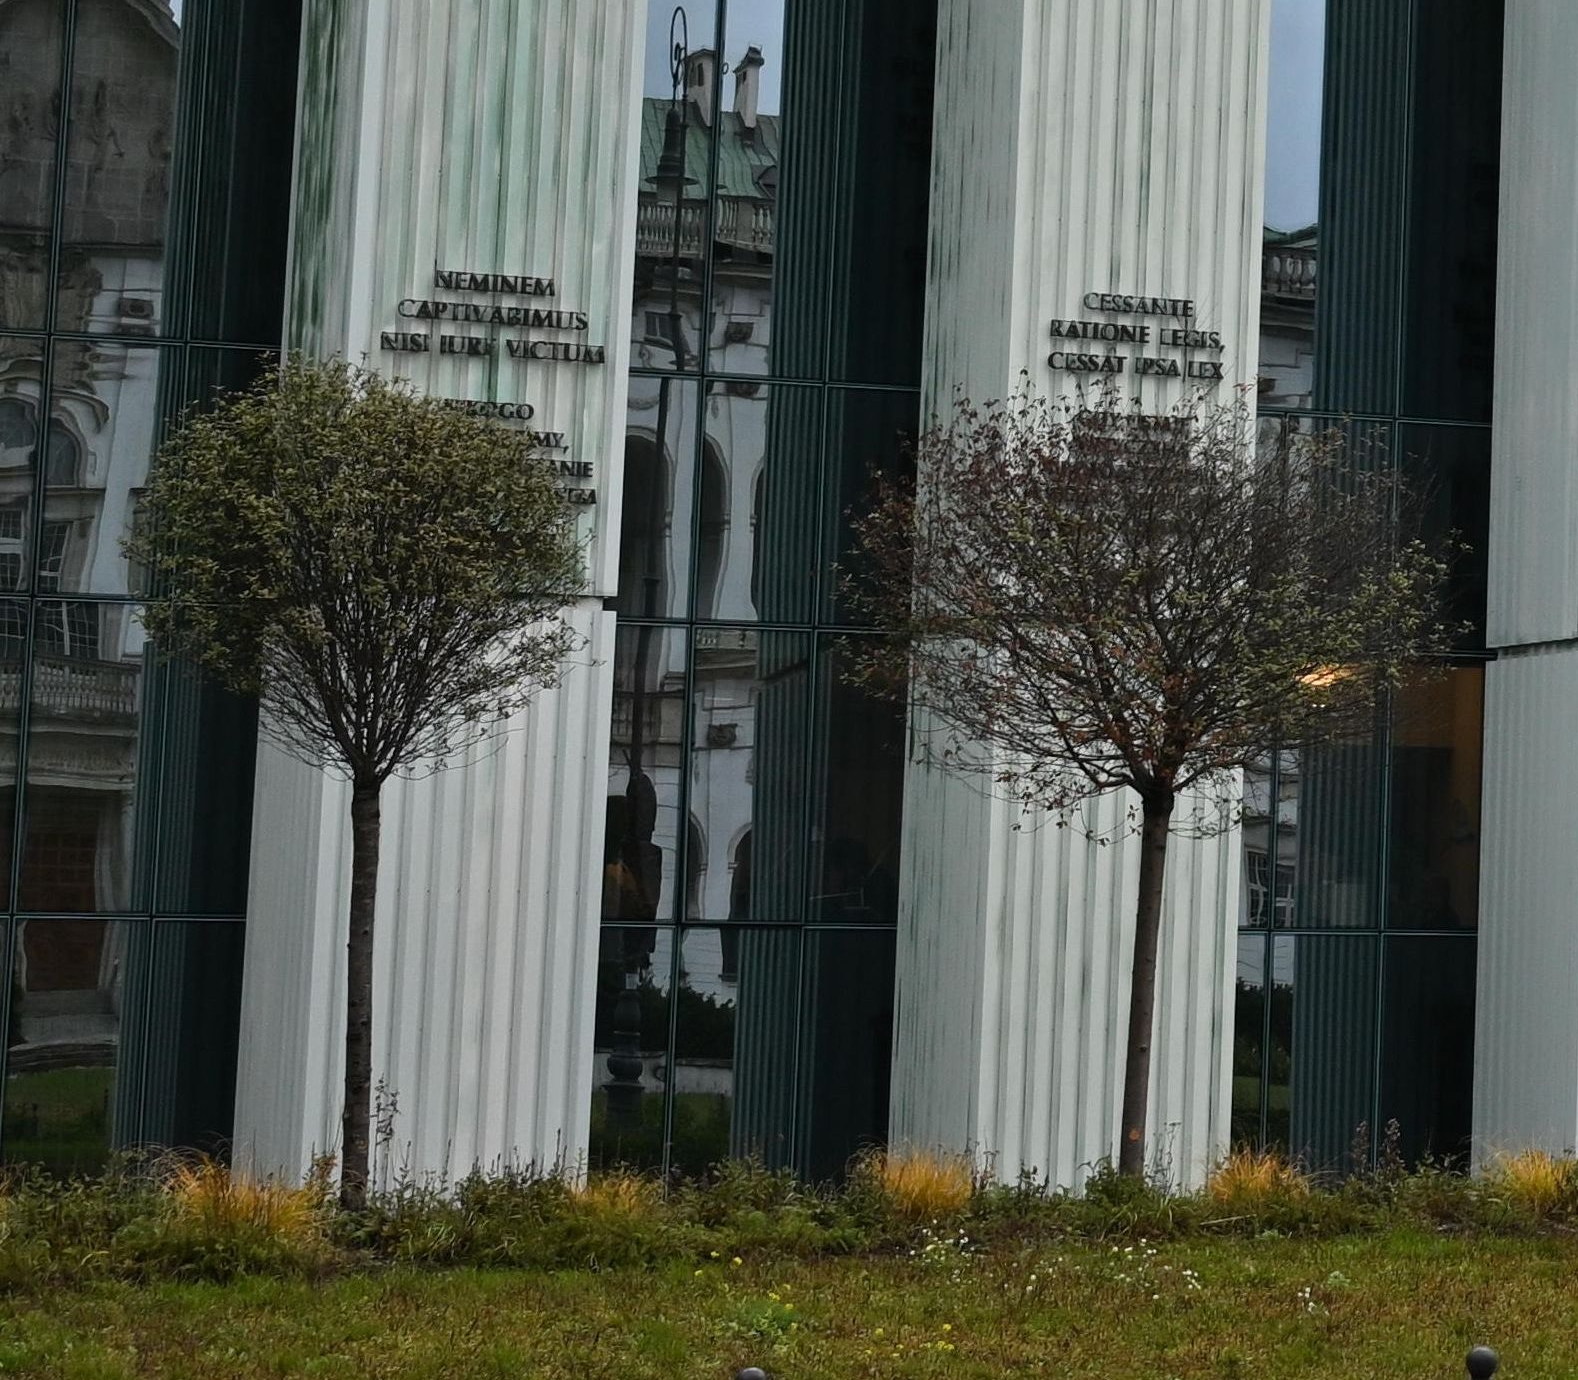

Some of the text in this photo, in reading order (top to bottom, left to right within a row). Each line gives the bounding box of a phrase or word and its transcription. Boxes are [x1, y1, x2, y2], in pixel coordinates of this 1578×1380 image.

[435, 270, 555, 296] NEMINEM
[398, 299, 588, 330] CAPTIVABIMUS
[1084, 293, 1193, 317] CESSANTE
[381, 332, 605, 363] NISI IURE VICTUM
[1050, 320, 1225, 353] RATIONE LEGIS,
[1048, 351, 1224, 379] CESSAT IPSA LEX
